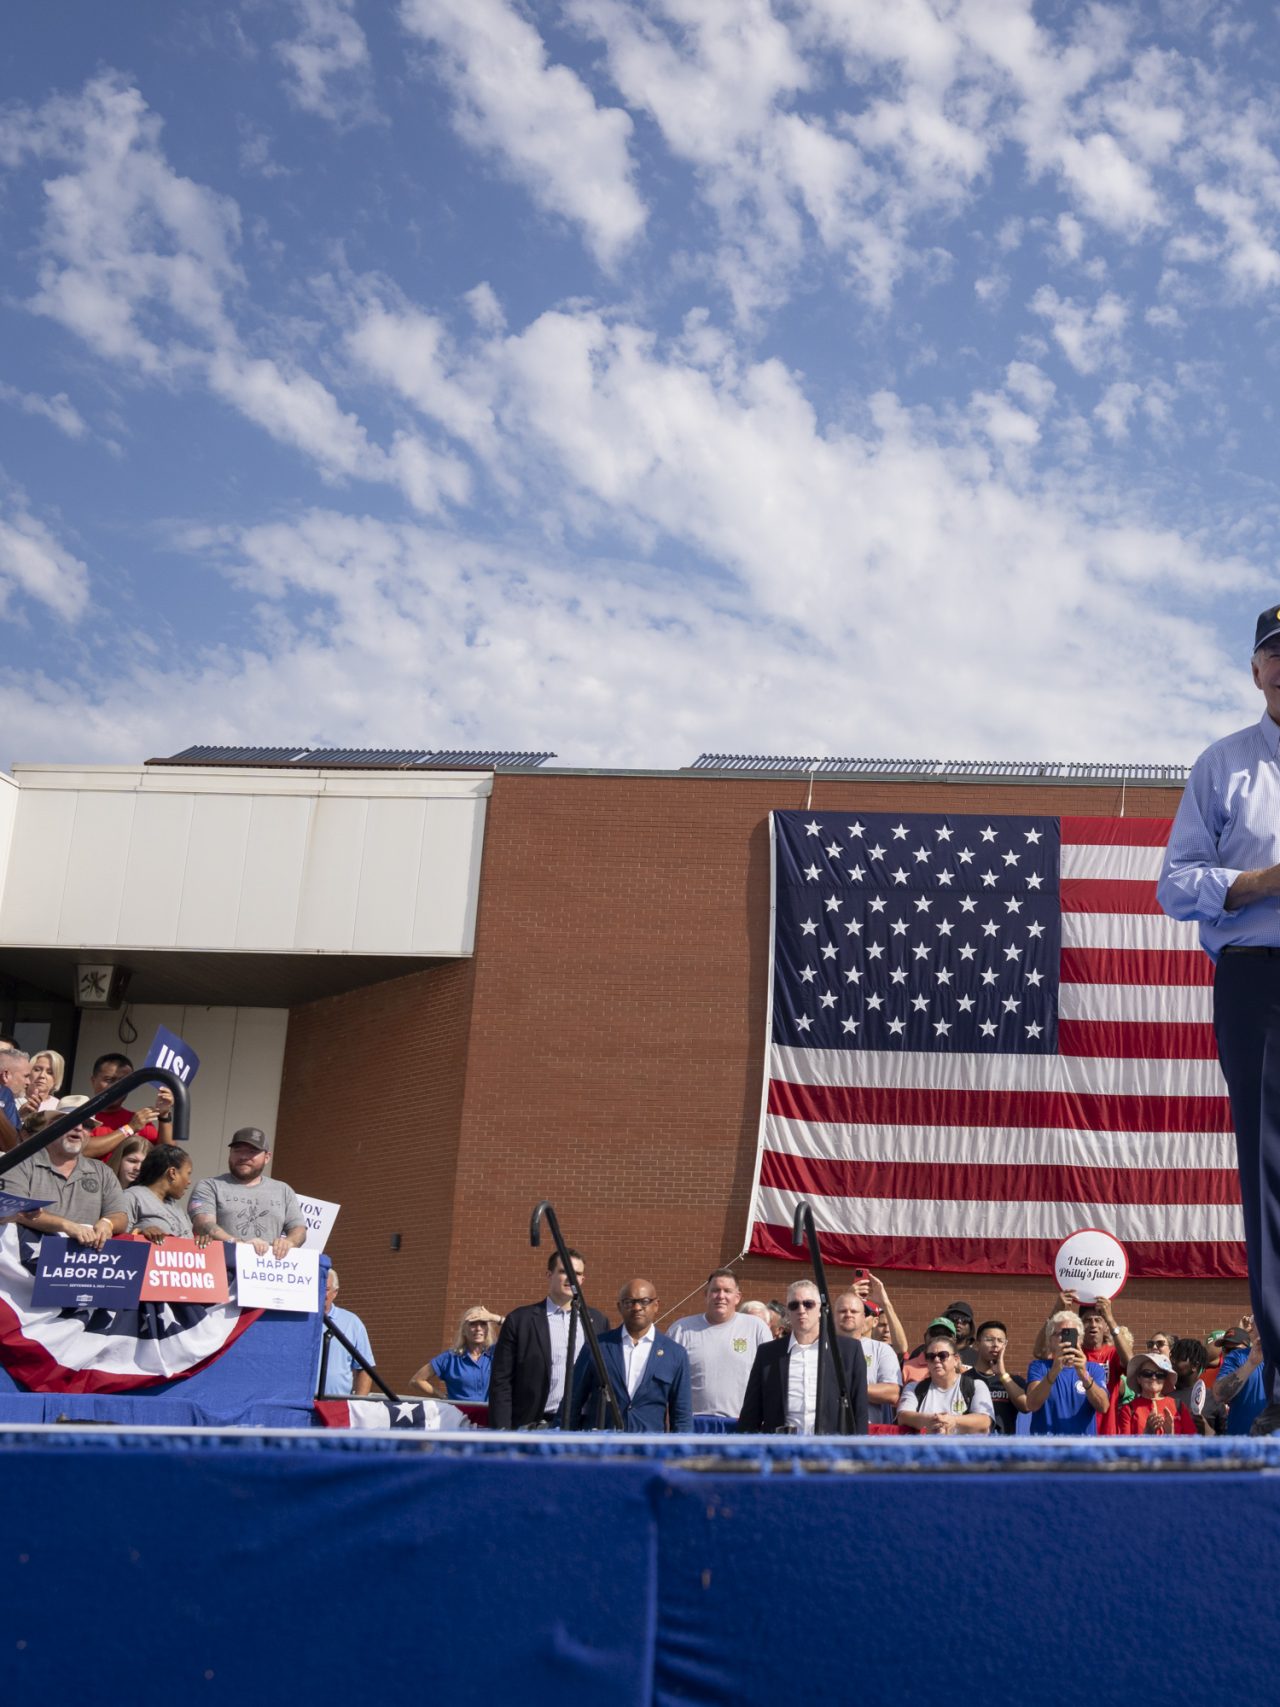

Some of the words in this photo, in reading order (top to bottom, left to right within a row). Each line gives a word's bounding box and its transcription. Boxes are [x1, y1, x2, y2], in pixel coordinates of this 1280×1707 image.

[63, 1251, 122, 1266] HAPPY
[154, 1250, 206, 1269] UNION
[256, 1257, 299, 1271] HAPPY
[1067, 1256, 1073, 1264] I
[1074, 1256, 1105, 1267] believe
[1105, 1258, 1115, 1267] in
[42, 1265, 98, 1280] LABOR
[102, 1267, 138, 1281] DAY
[149, 1270, 215, 1289] STRONG
[243, 1269, 284, 1283] LABOR
[287, 1273, 313, 1286] DAY
[1059, 1267, 1091, 1281] Philly's
[1091, 1269, 1122, 1281] future.
